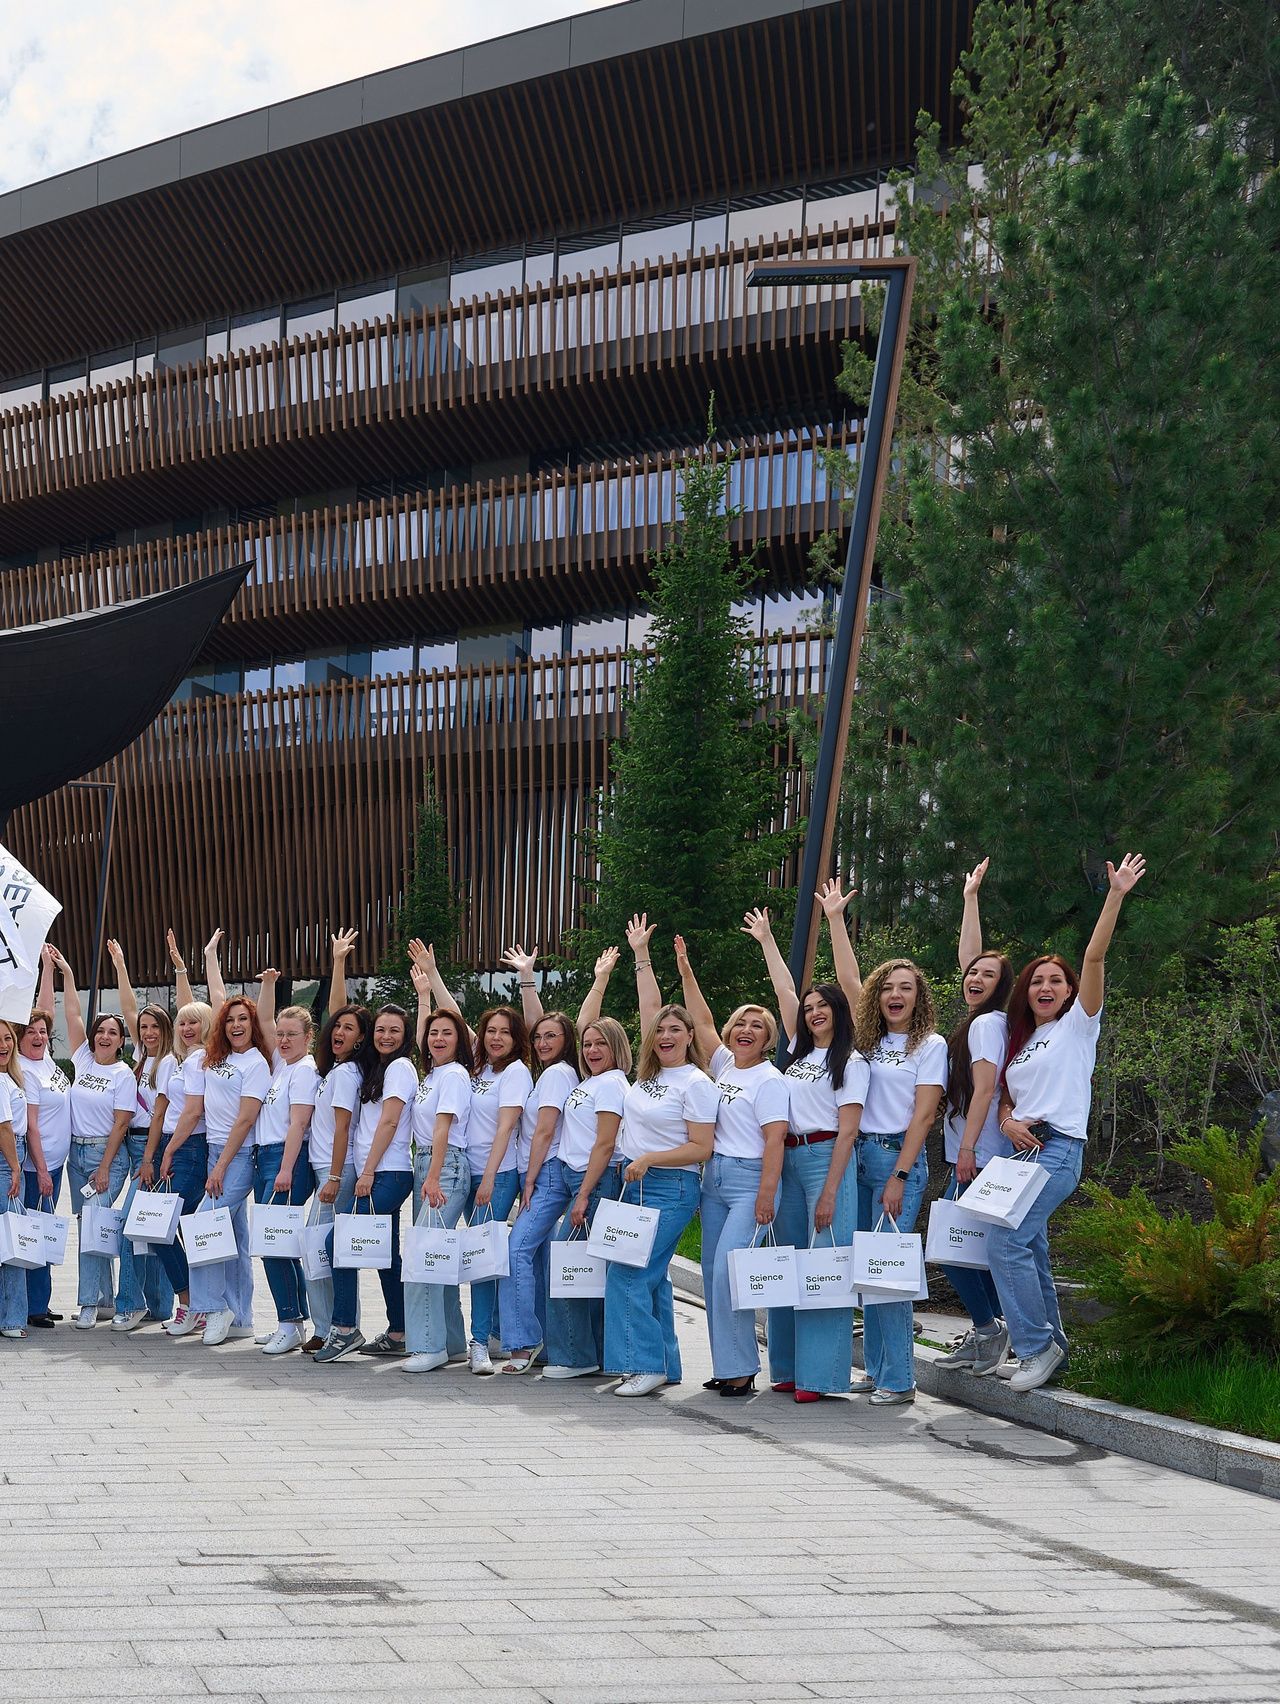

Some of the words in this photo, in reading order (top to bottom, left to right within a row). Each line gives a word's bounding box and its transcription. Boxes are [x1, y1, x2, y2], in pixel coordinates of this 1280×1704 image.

[978, 1187, 991, 1196] lab
[983, 1181, 1012, 1193] Science
[138, 1210, 163, 1218] Science
[100, 1226, 118, 1235] Scienc
[264, 1227, 293, 1235] Science
[605, 1225, 639, 1239] Science
[949, 1226, 985, 1238] Science
[18, 1233, 38, 1244] Science
[194, 1231, 223, 1241] Science
[603, 1233, 617, 1242] lab
[949, 1235, 963, 1243] lab
[351, 1237, 381, 1245] Science
[351, 1244, 363, 1252] lab
[424, 1251, 451, 1261] Science
[462, 1248, 486, 1258] Science
[868, 1258, 905, 1267] Science
[868, 1266, 882, 1274] lab
[562, 1273, 575, 1281] lab
[749, 1274, 784, 1282] Science
[805, 1274, 842, 1283] Science
[750, 1282, 764, 1290] lab
[806, 1283, 821, 1291] lab
